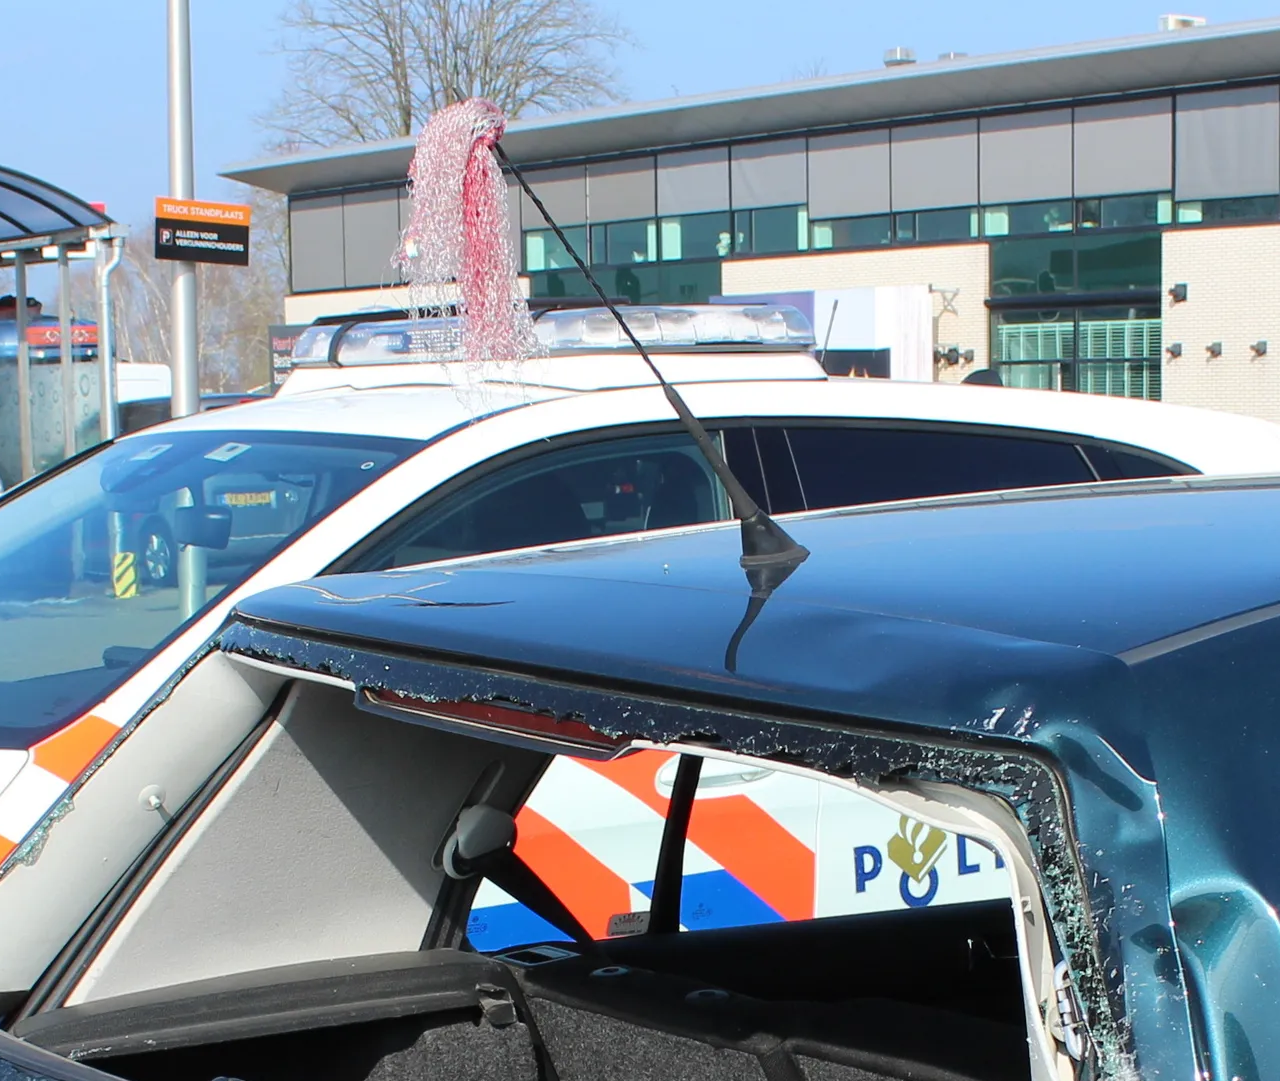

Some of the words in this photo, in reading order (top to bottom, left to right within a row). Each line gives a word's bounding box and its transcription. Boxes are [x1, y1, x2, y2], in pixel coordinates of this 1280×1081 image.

[162, 203, 189, 215] TRUCK
[190, 206, 245, 220] STANDPLAATS
[162, 230, 170, 243] P
[175, 229, 200, 239] ALLEEN
[200, 231, 218, 240] VOOR
[174, 238, 245, 252] VERGUNNINGHOUDERS
